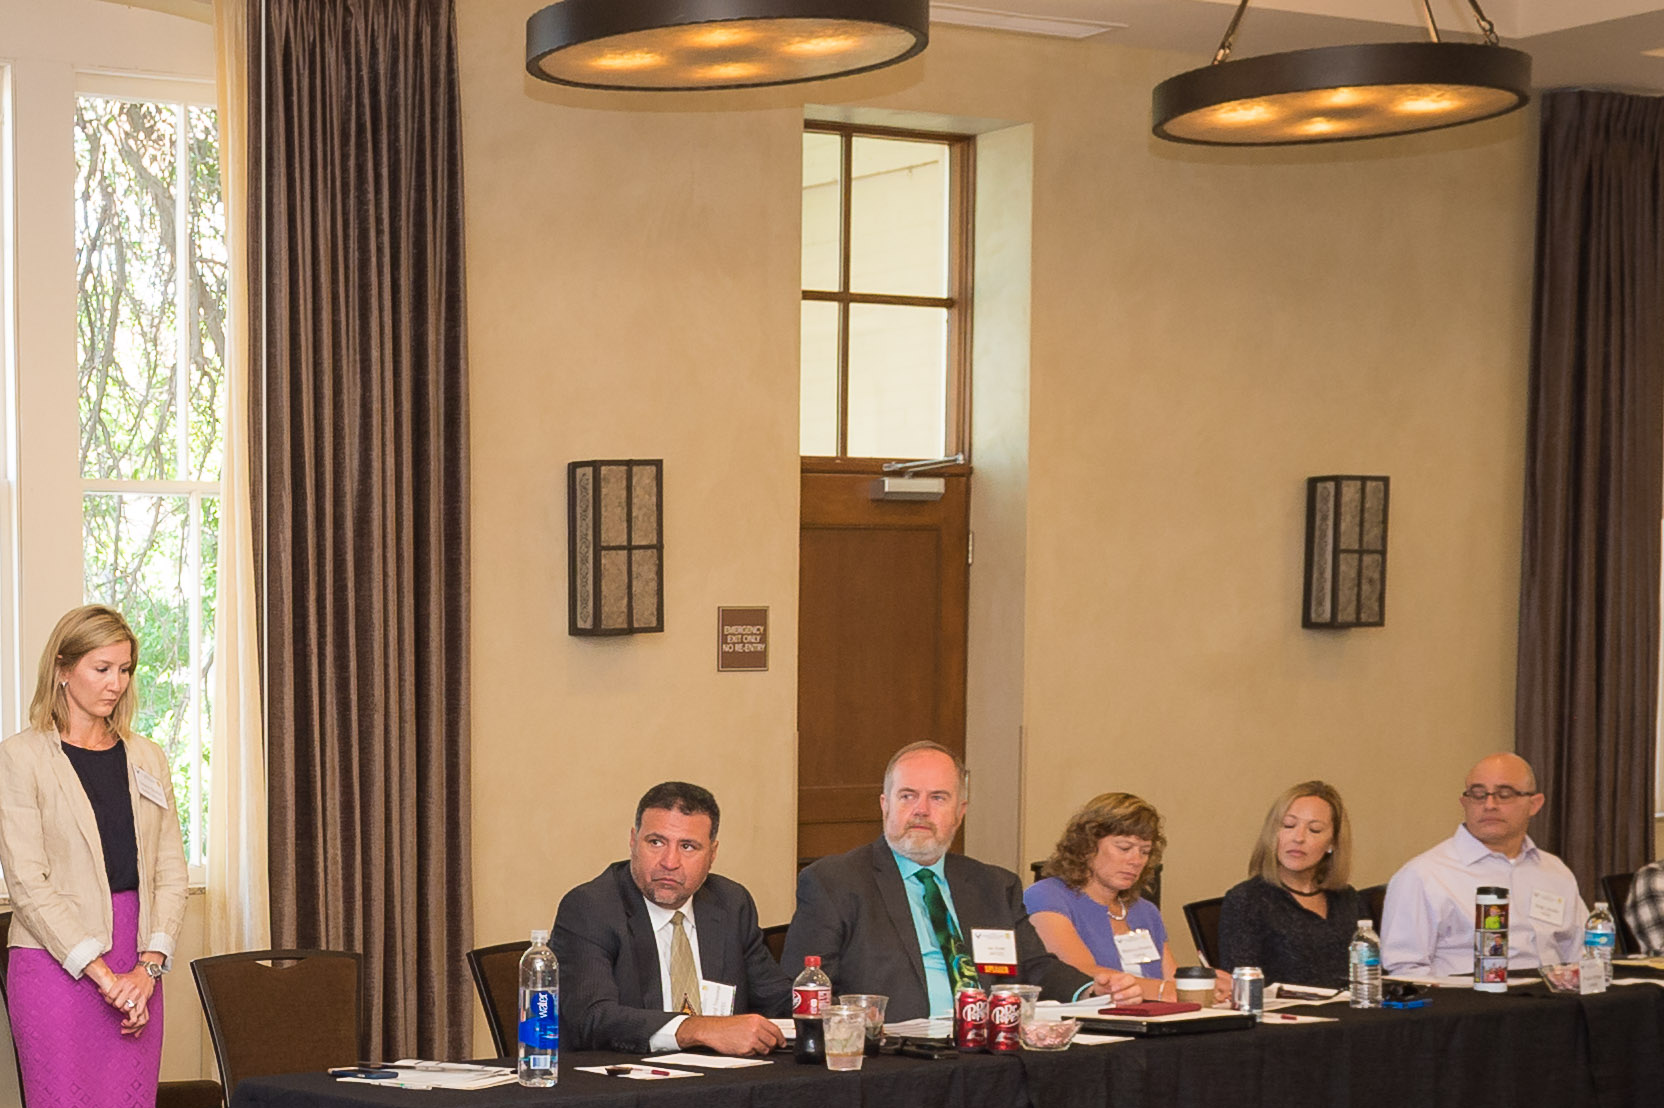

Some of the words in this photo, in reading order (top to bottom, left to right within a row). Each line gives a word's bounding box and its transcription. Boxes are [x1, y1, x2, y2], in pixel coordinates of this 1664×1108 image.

[723, 625, 765, 634] EMERGENCY
[727, 634, 742, 643] EXIT
[743, 634, 761, 643] ONLY
[722, 643, 734, 652] NO
[735, 643, 766, 652] RE-ENTRY
[537, 992, 548, 1018] water
